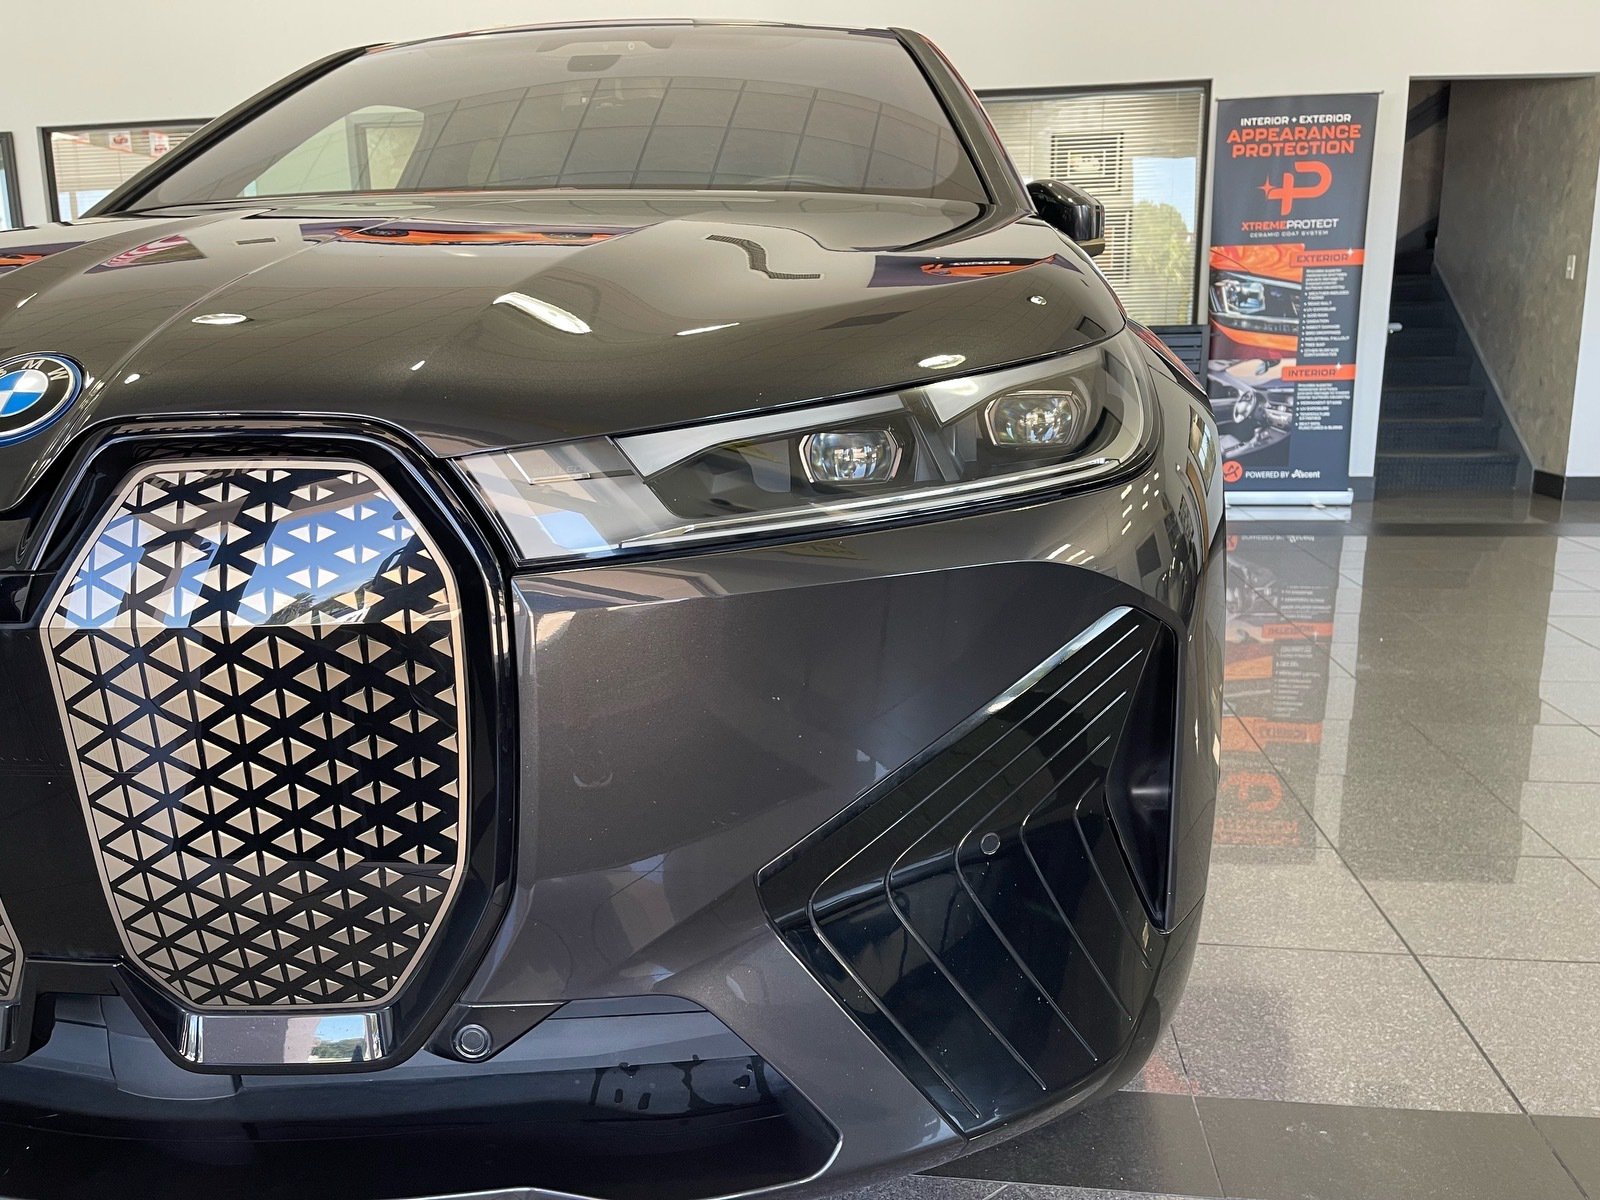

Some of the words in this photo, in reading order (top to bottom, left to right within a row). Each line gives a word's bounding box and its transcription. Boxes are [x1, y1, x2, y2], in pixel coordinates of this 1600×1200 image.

[1240, 116, 1289, 127] INTERIOR
[1299, 113, 1352, 124] EXTERIOR
[1226, 124, 1362, 144] APPEARANCE
[1231, 140, 1355, 158] PROTECTION
[1296, 253, 1349, 263] EXTERIOR
[1288, 367, 1337, 377] INTERIOR
[1245, 470, 1280, 479] POWERED
[1280, 470, 1290, 478] BY
